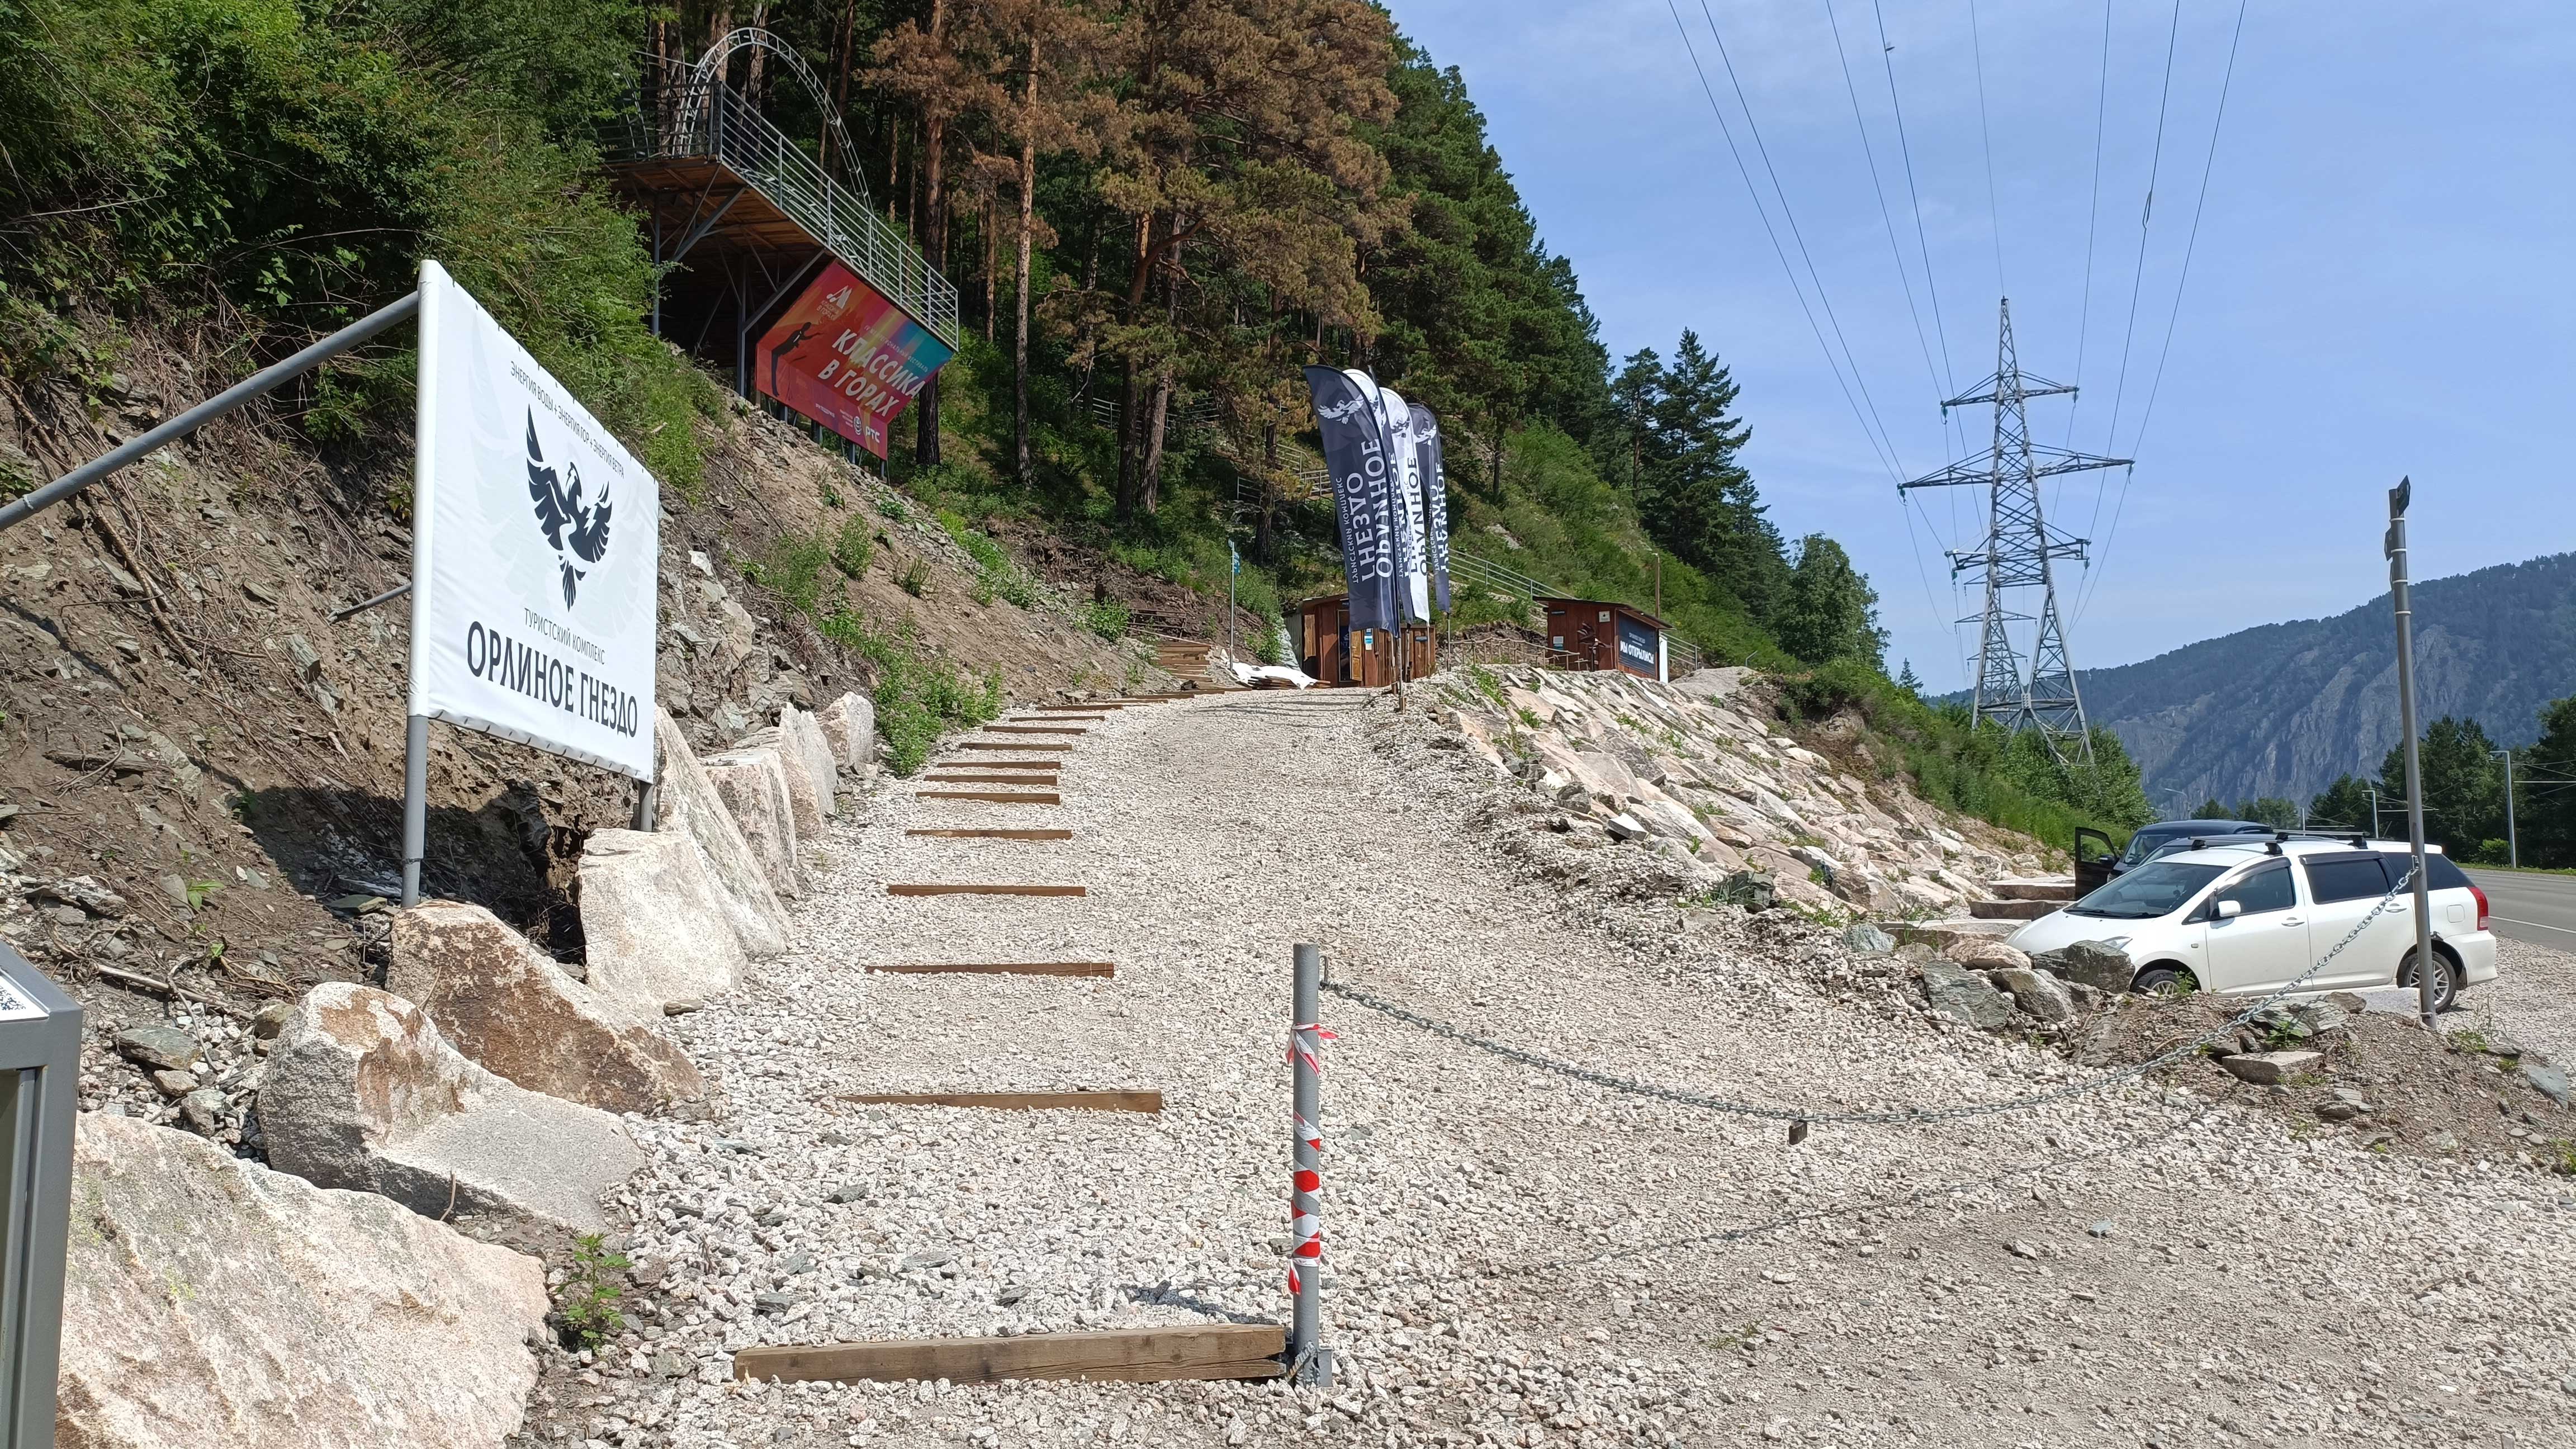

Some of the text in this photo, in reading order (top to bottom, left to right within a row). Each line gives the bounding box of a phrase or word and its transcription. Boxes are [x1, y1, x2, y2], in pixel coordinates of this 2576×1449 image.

[818, 359, 840, 380] В
[834, 370, 899, 416] ГОРАХ
[832, 328, 926, 399] КЛАССИКА
[511, 361, 537, 396] ЭНЕРГИЯ
[537, 385, 553, 411] ВОДЫ
[558, 405, 580, 436] ЭНЕРГИЯ
[580, 427, 590, 444] ГОР
[593, 439, 612, 467] ЭНЕРГИЯ
[612, 457, 624, 479] ВЕТРА
[524, 608, 605, 665] ТУРИСТСКИЙ КОМПЛЕКС
[467, 621, 638, 738] ОРЛИНОЕ ГНЕЗДО
